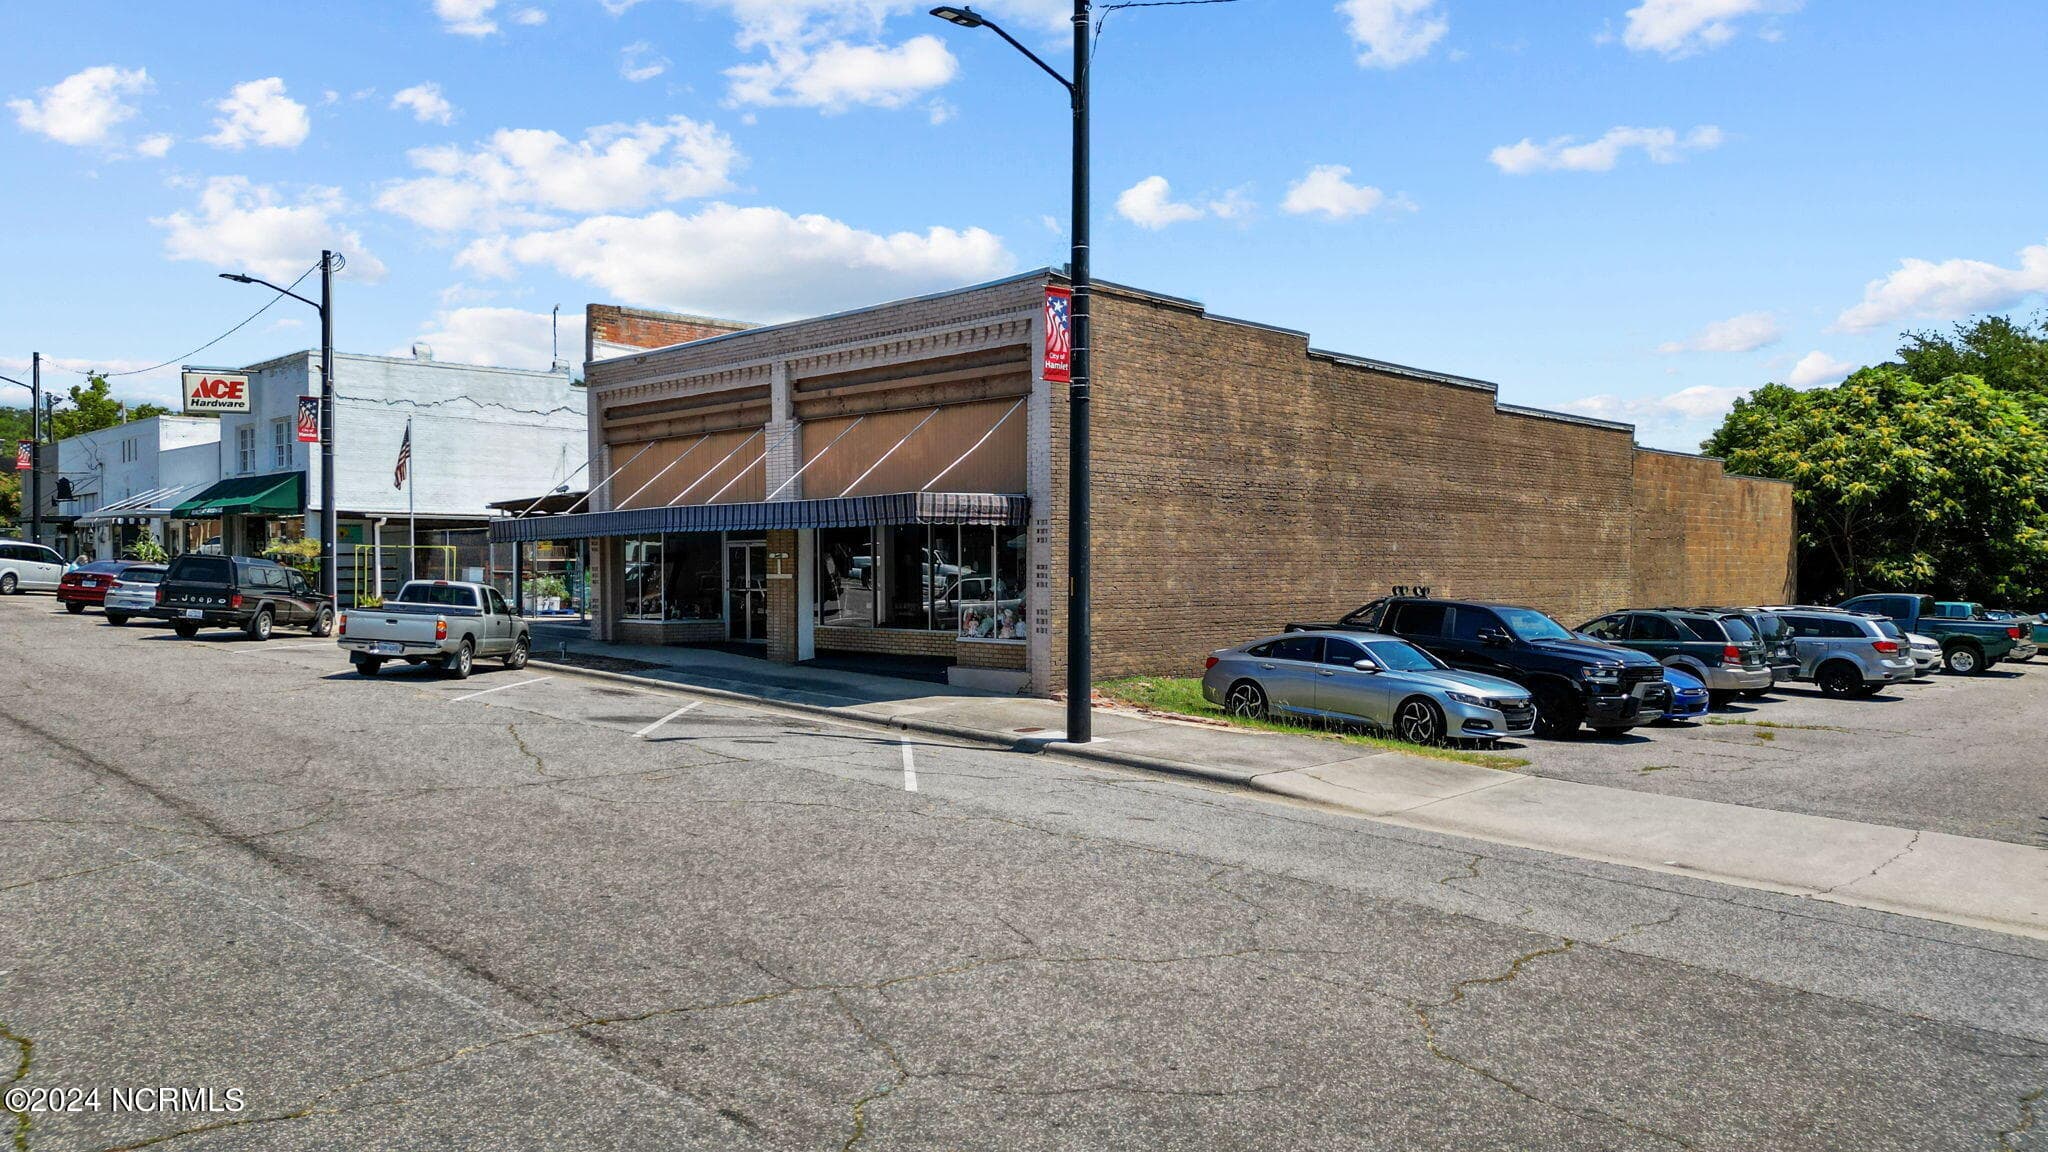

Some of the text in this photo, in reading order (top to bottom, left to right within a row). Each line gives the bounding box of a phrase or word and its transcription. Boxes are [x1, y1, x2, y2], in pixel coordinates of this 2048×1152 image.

[1045, 361, 1068, 370] Hamlet
[191, 377, 245, 399] ACE
[190, 399, 245, 408] Hardware
[181, 594, 212, 604] Jeep
